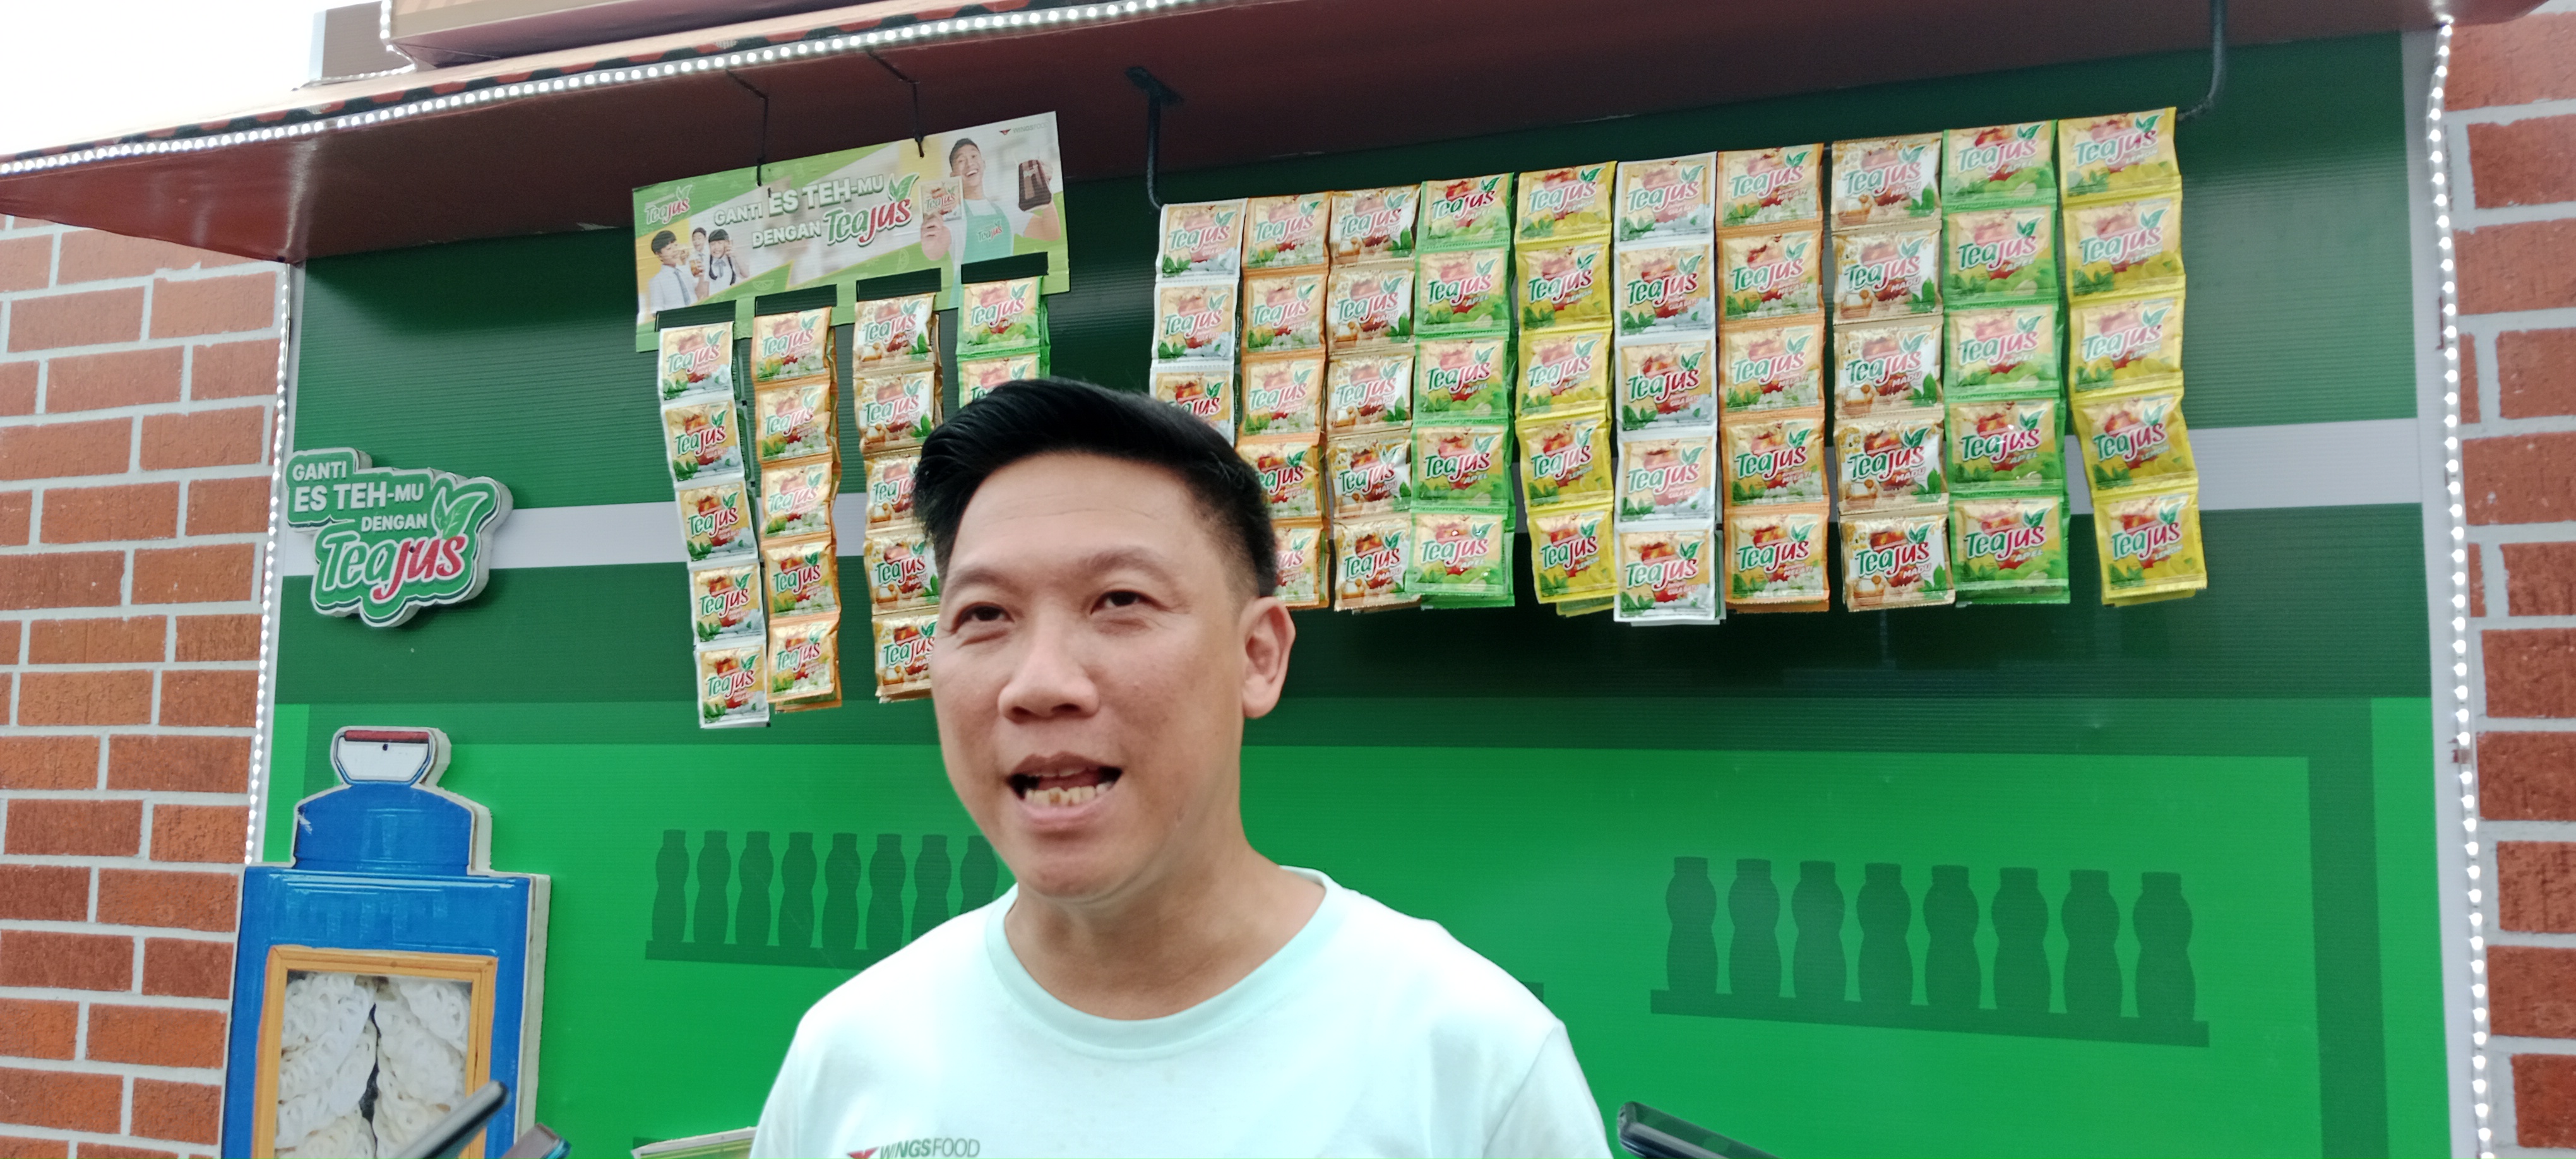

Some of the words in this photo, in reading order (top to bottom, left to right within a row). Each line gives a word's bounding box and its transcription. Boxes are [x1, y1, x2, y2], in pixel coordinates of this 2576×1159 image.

[1957, 138, 2037, 172] Teajus
[2073, 130, 2157, 167] Teajus
[1731, 165, 1804, 200] Teajus
[1844, 162, 1921, 197] Teajus
[1890, 181, 1921, 197] MADU
[645, 197, 690, 225] Teajus
[714, 202, 763, 227] GANTI
[769, 186, 799, 216] ES
[802, 174, 883, 208] TEH-MU
[925, 194, 955, 210] Teajus
[1432, 189, 1496, 221] Teajus
[1529, 181, 1596, 214] Teajus
[1628, 181, 1700, 213] Teajus
[753, 222, 821, 249] DENGAN
[823, 196, 913, 246] Teajus
[977, 226, 1003, 242] Teajus
[1255, 213, 1315, 244] Teajus
[1340, 207, 1402, 238] Teajus
[1169, 225, 1231, 253] Teajus
[1957, 235, 2037, 272] Teajus
[2080, 226, 2162, 266] Teajus
[1732, 258, 1804, 293] Teajus
[1845, 256, 1920, 290] Teajus
[2006, 258, 2035, 271] APEL
[1428, 274, 1492, 305] Teajus
[1528, 269, 1593, 304] Teajus
[1626, 272, 1698, 308] Teajus
[1890, 277, 1921, 292] MADU
[971, 297, 1026, 328] Teajus
[1252, 297, 1311, 330] Teajus
[1337, 291, 1398, 321] Teajus
[1465, 295, 1489, 307] APEL
[863, 314, 917, 343] Teajus
[1164, 309, 1223, 339] Teajus
[763, 328, 814, 359] Teajus
[1959, 331, 2039, 366] Teajus
[2083, 324, 2162, 361] Teajus
[668, 345, 720, 376] Teajus
[1527, 355, 1592, 388] Teajus
[1732, 352, 1805, 385] Teajus
[1846, 351, 1921, 386] Teajus
[2007, 353, 2036, 366] APEL
[1337, 377, 1397, 408] Teajus
[1426, 362, 1491, 393] Teajus
[1464, 383, 1488, 395] APEL
[1627, 369, 1700, 403] Teajus
[1892, 372, 1923, 387] MADU
[866, 395, 919, 425] Teajus
[1249, 381, 1308, 412] Teajus
[765, 407, 814, 437] Teajus
[675, 425, 727, 456] Teajus
[1961, 427, 2040, 463] Teajus
[2093, 422, 2166, 462] Teajus
[292, 461, 347, 481] GANTI
[1424, 451, 1491, 482] Teajus
[1532, 444, 1593, 480] Teajus
[1736, 446, 1807, 481] Teajus
[1847, 445, 1925, 482] Teajus
[2009, 451, 2039, 465] APEL
[1340, 461, 1395, 494] Teajus
[1463, 473, 1488, 484] APEL
[1628, 463, 1700, 495] Teajus
[1895, 467, 1926, 483] MADU
[294, 485, 327, 513] ES
[333, 481, 424, 511] TEH-MU
[768, 486, 820, 514] Teajus
[873, 478, 916, 505] Teaju
[361, 514, 428, 532] DENGAN
[688, 506, 739, 537] Teajus
[1421, 538, 1489, 568] Teajus
[1540, 535, 1599, 571] Teajus
[1738, 540, 1810, 573] Teajus
[1965, 525, 2046, 560] Teajus
[2014, 549, 2044, 562] APEL
[2111, 521, 2181, 561] Teajus
[322, 530, 468, 603] Teajus
[876, 556, 926, 585] Teajus
[1344, 547, 1402, 581] Teajus
[1625, 558, 1698, 591] Teajus
[1855, 542, 1930, 577] Teajus
[1903, 564, 1931, 578] MADU
[773, 564, 821, 594] Teajus
[699, 588, 750, 618] Teajus
[777, 642, 820, 672] Teajus
[884, 636, 935, 669] Teajus
[916, 657, 932, 669] MAD
[708, 669, 754, 698] Teajus
[880, 1138, 980, 1159] WINGSFOOD
